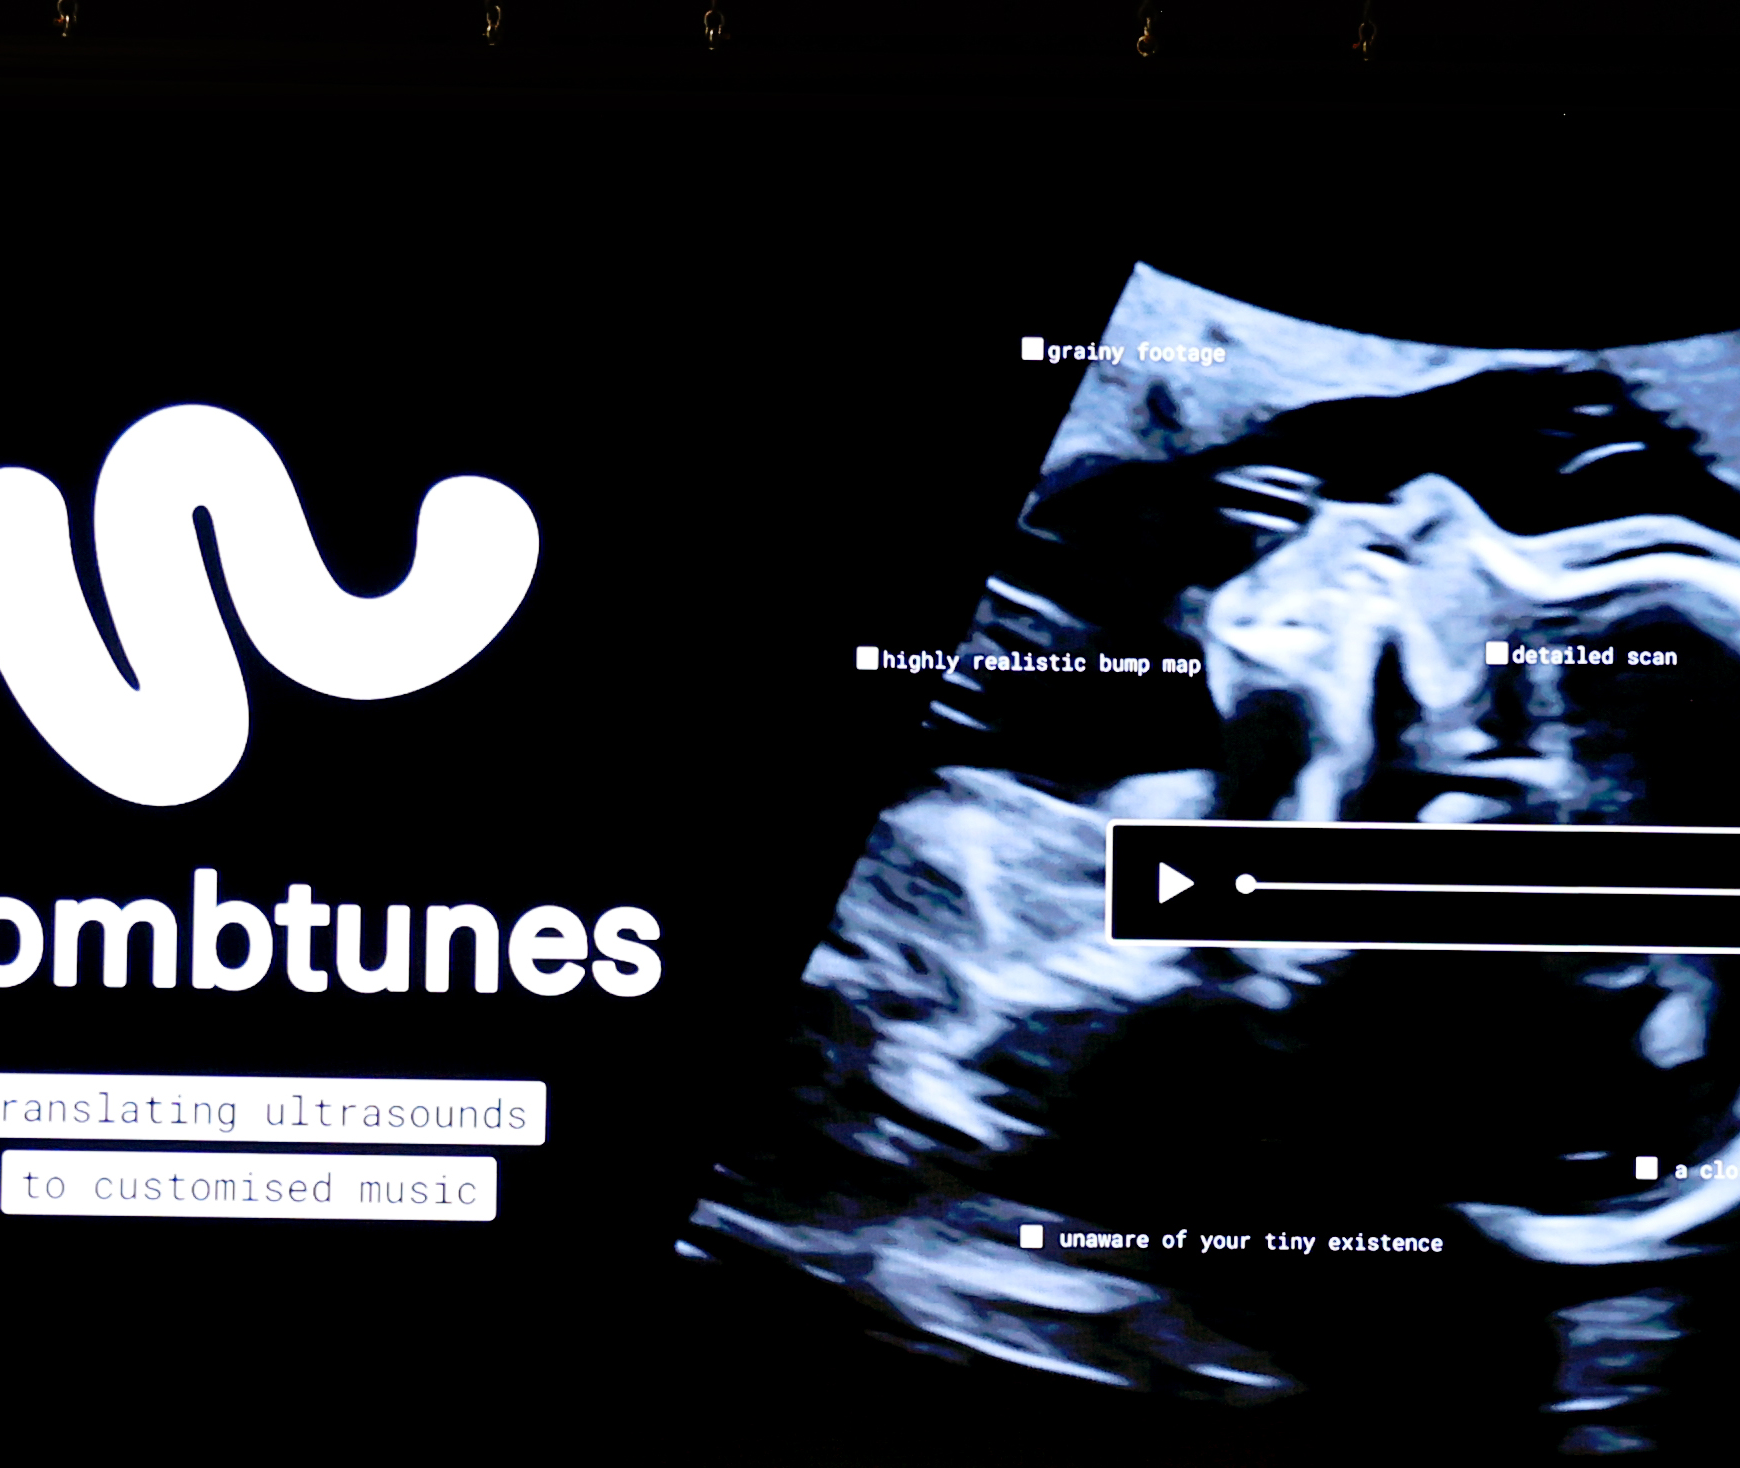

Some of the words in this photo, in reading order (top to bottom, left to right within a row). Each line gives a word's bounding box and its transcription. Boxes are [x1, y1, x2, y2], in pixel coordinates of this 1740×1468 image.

[1048, 341, 1125, 365] grainy
[1137, 341, 1226, 367] footage
[883, 650, 959, 674] highly
[973, 652, 1086, 673] realistic
[1099, 653, 1150, 677] bump
[1162, 658, 1202, 678] map
[1512, 645, 1614, 665] detailed
[1627, 650, 1678, 666] scan
[265, 1093, 527, 1130] ultrasounds
[1675, 1164, 1688, 1179] a
[23, 1170, 65, 1199] to
[93, 1171, 333, 1204] customised
[359, 1174, 477, 1206] music
[1059, 1231, 1150, 1249] unaware
[1162, 1228, 1188, 1249] of
[1200, 1234, 1251, 1254] your
[1265, 1231, 1316, 1255] tiny
[1328, 1232, 1444, 1253] existence
